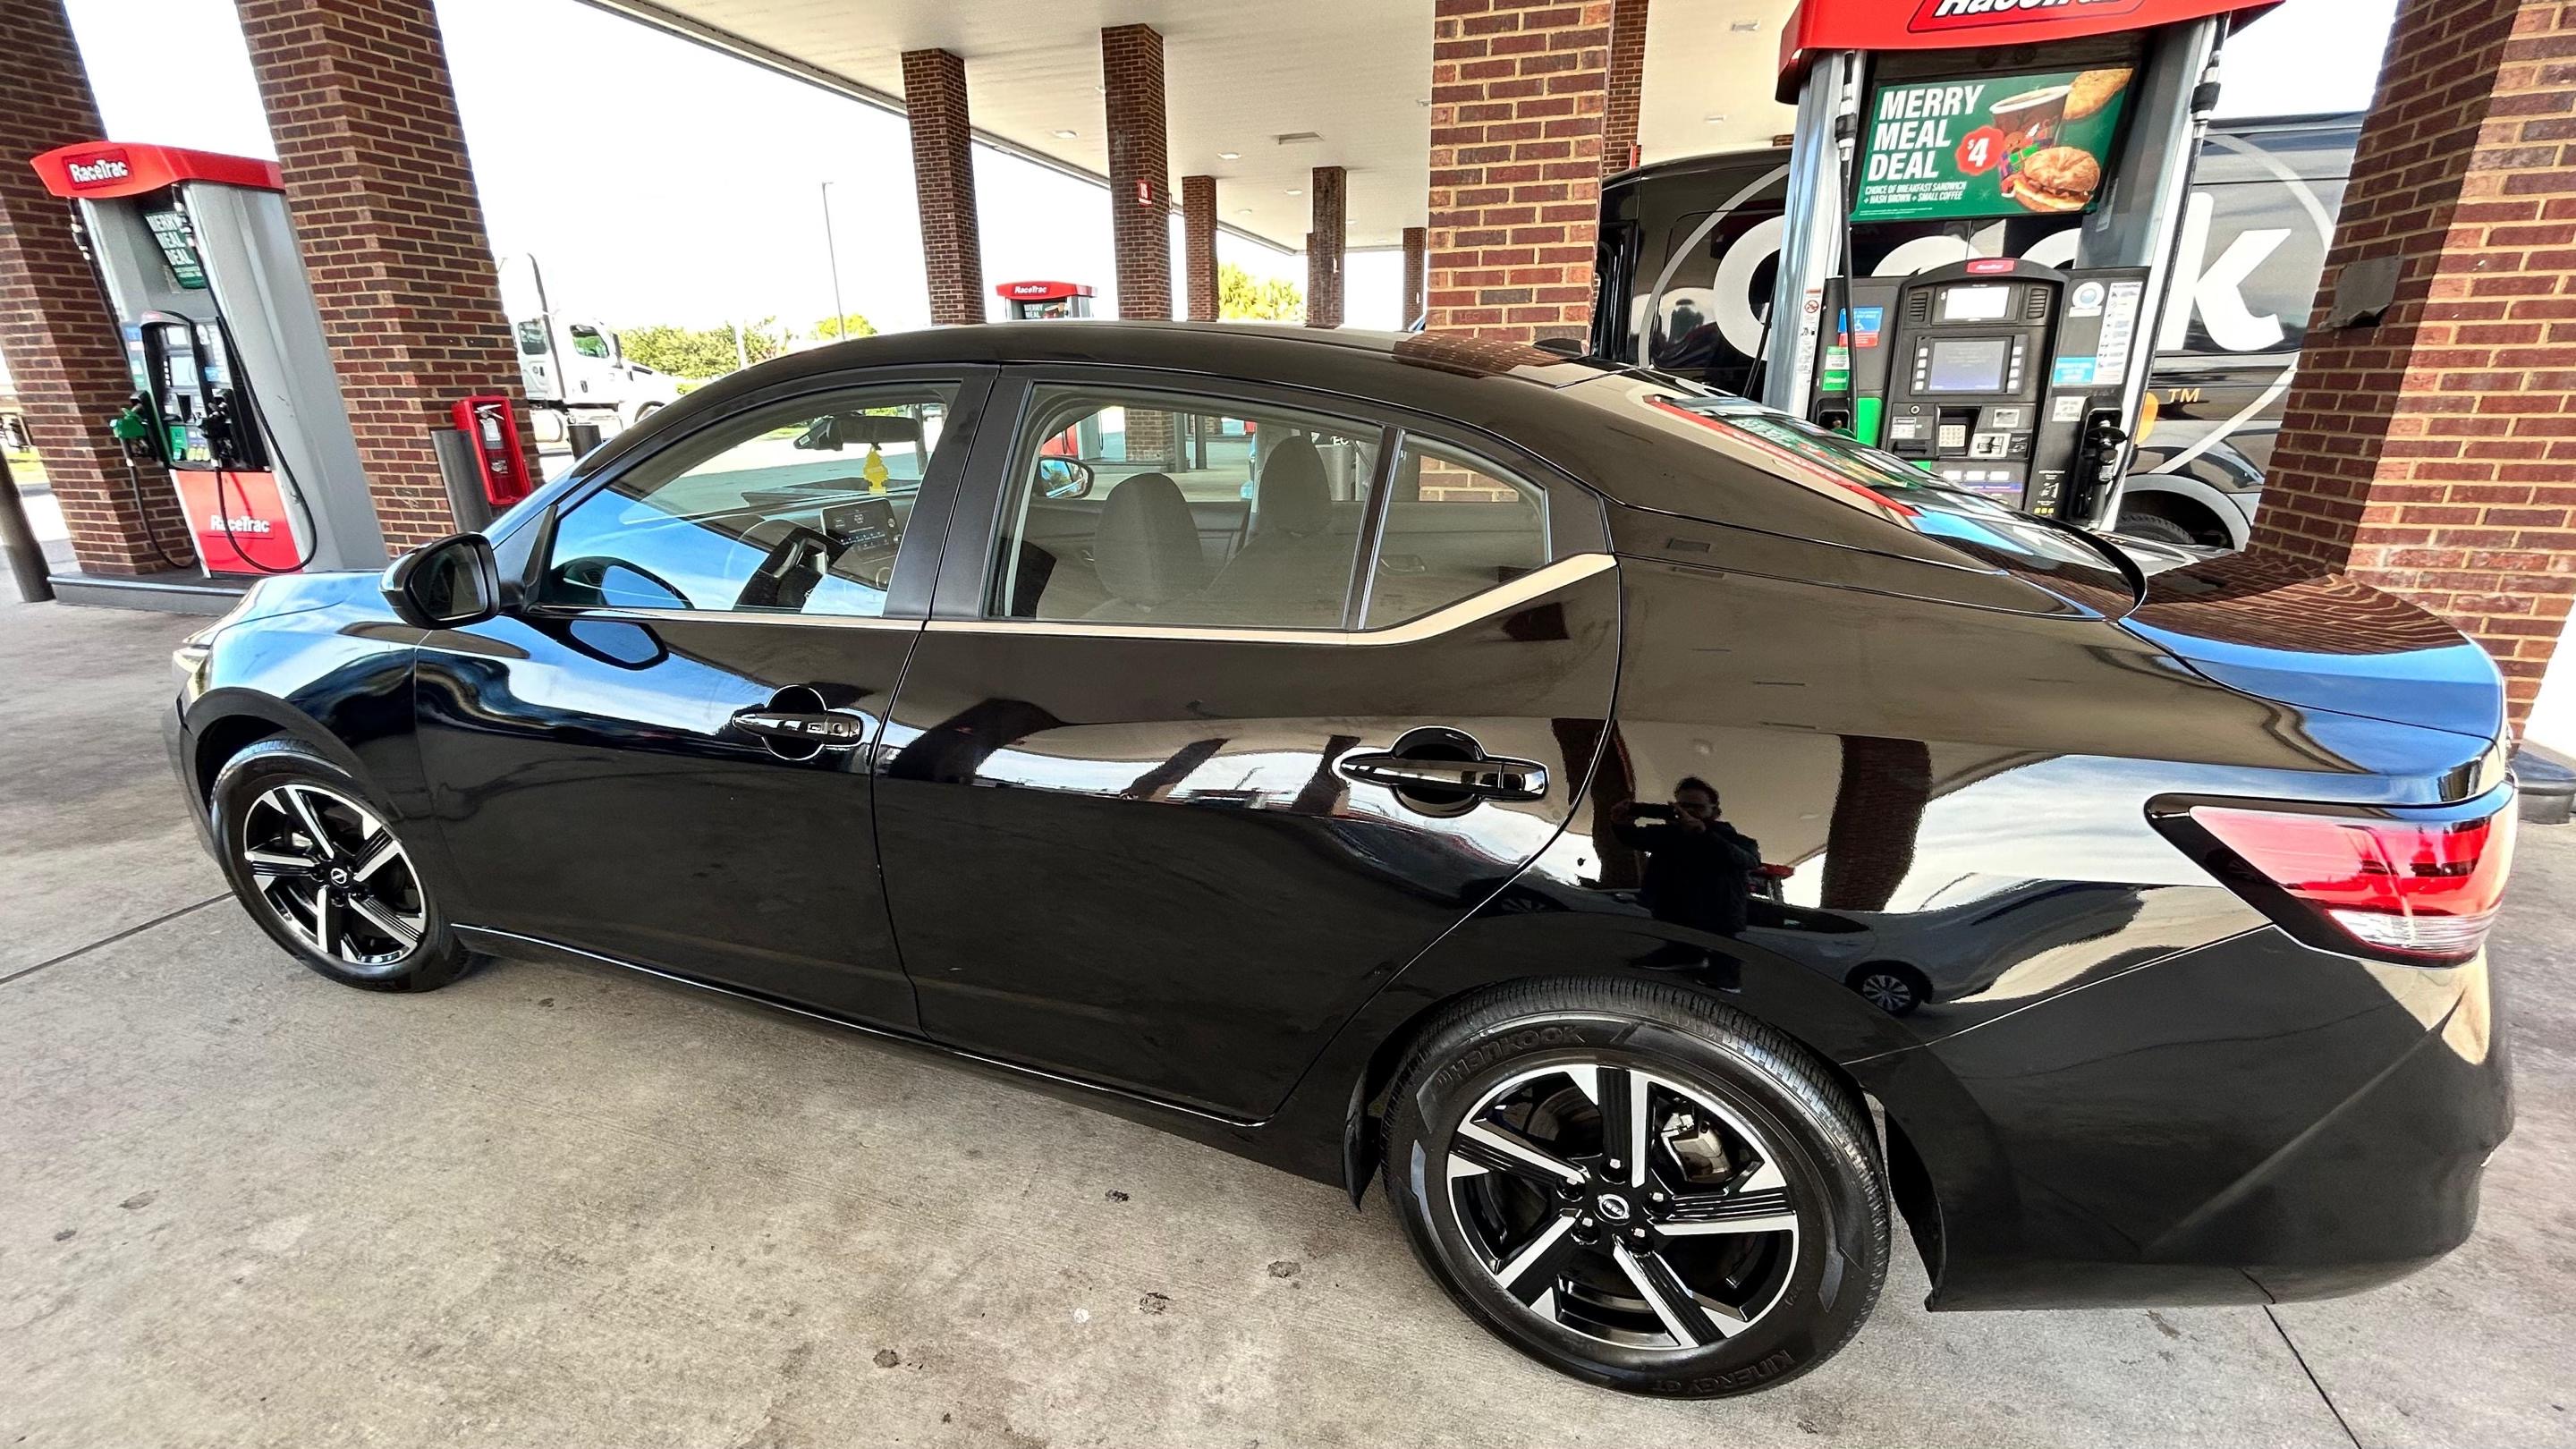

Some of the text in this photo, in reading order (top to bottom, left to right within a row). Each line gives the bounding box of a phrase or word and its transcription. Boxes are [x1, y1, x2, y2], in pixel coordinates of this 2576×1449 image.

[1879, 85, 1986, 121] MERRY
[1873, 119, 1952, 151] MEAL
[1967, 138, 1990, 167] $4
[69, 159, 128, 182] RaceTrac
[1867, 150, 1940, 182] DEAL
[1864, 181, 1968, 196] CHOICE OF BREAKFAST SANDWICH
[1869, 194, 1888, 204] HASH
[1887, 193, 1912, 204] BROWN
[1917, 192, 1940, 202] SMALL
[1938, 191, 1964, 201] COFFEE
[165, 248, 195, 266] DEAL
[1014, 285, 1047, 294] RaceTrac
[2167, 387, 2200, 403] TM
